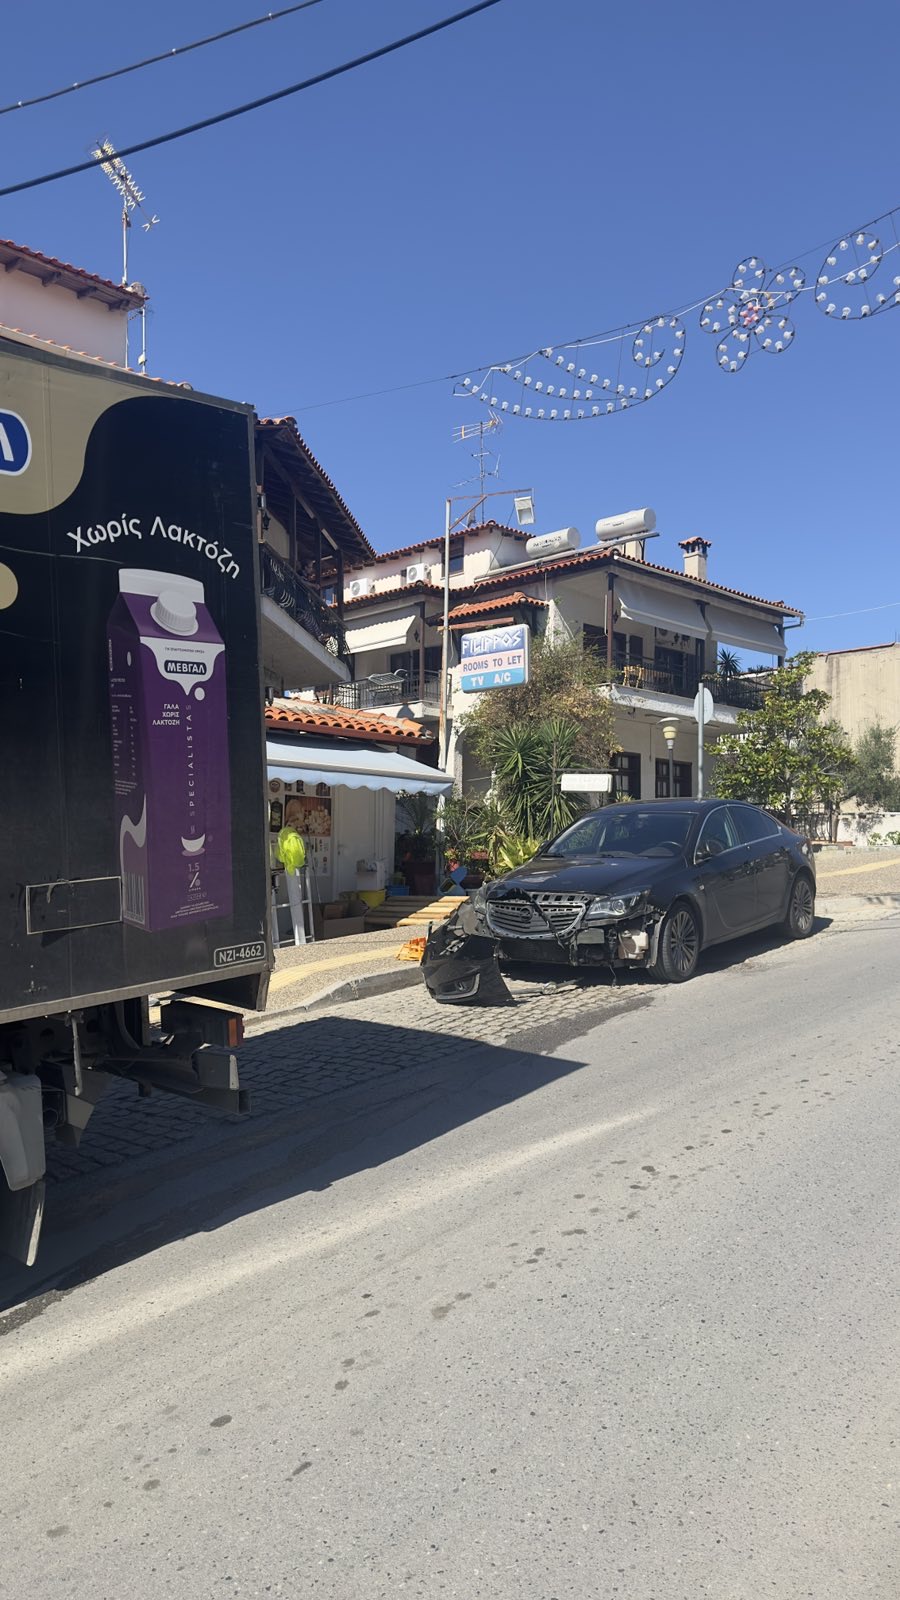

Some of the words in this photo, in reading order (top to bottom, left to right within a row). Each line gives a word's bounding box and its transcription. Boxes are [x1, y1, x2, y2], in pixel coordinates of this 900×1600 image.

[66, 513, 142, 553] Χωρίς
[150, 516, 240, 579] Λακτόζη
[167, 662, 205, 673] ΜΕΒΓΑΛ
[463, 660, 488, 672] ROOMS
[493, 658, 503, 667] TO
[508, 655, 521, 665] LET
[471, 676, 484, 687] TV
[494, 672, 511, 684] A/C
[188, 862, 200, 872] 1.5
[219, 945, 262, 963] NZI-4662
